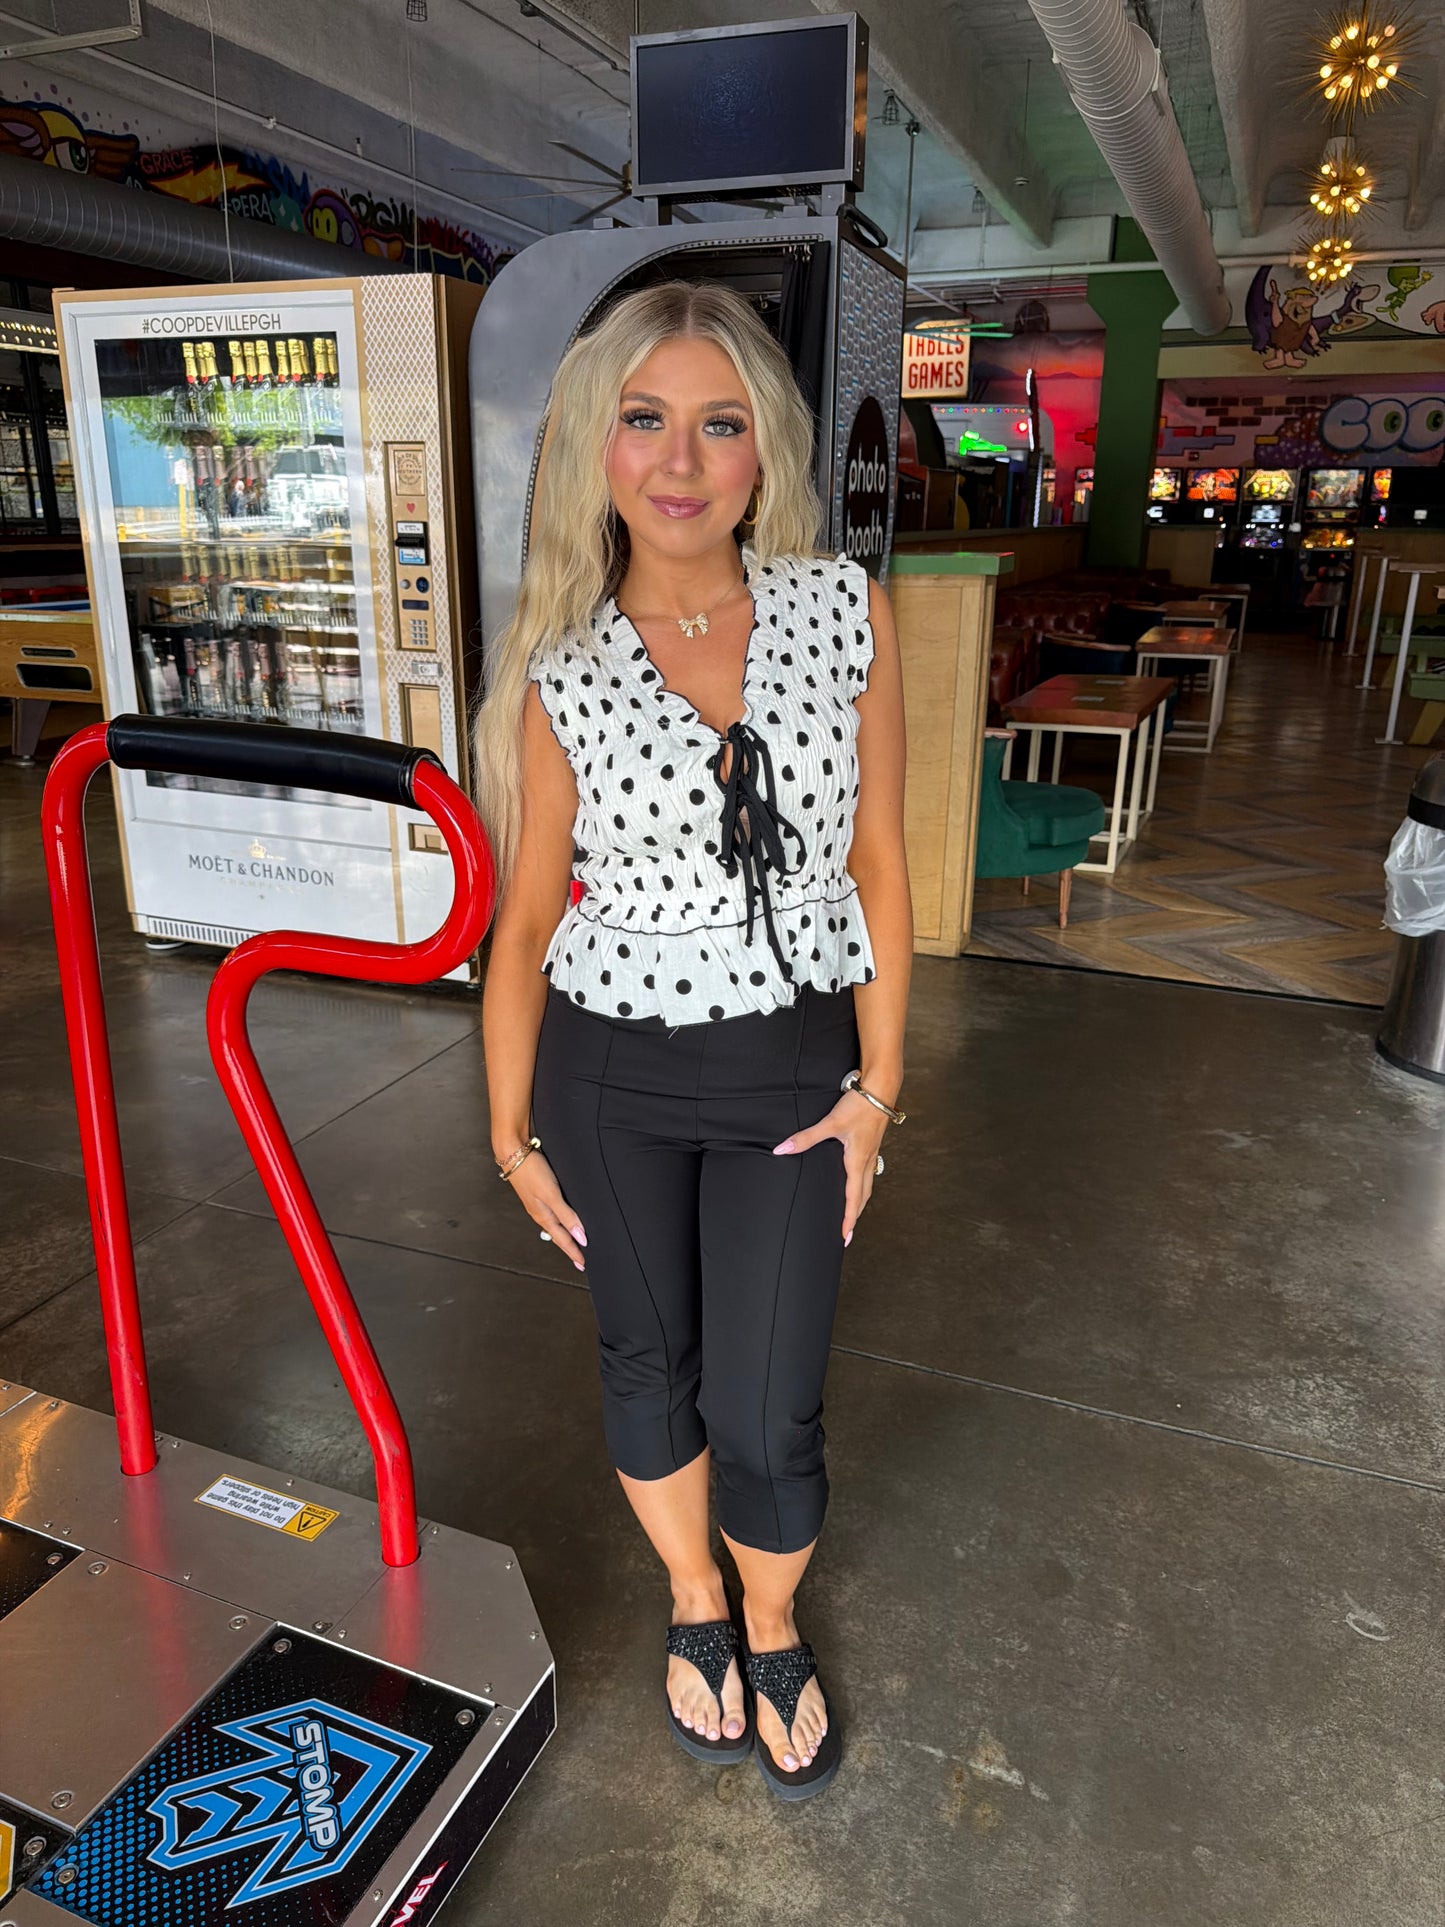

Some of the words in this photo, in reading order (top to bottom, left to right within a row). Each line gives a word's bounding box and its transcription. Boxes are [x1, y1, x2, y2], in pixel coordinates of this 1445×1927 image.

[140, 150, 194, 174] GRACE
[142, 313, 282, 334] #COOPDEVILLEPGH
[908, 361, 965, 390] GAMES
[848, 442, 887, 500] photo
[846, 507, 884, 559] booth
[237, 862, 248, 876] &
[250, 862, 335, 887] CHANDON
[206, 1493, 228, 1504] game
[227, 1490, 258, 1505] wearing
[251, 1489, 261, 1497] or
[261, 1493, 284, 1505] heels
[227, 1500, 244, 1509] this
[243, 1504, 260, 1517] play
[259, 1501, 280, 1513] while
[282, 1500, 301, 1511] high
[260, 1509, 275, 1519] not
[305, 1506, 332, 1518] CAUTION
[274, 1515, 286, 1524] Do
[293, 1721, 339, 1848] STOMP
